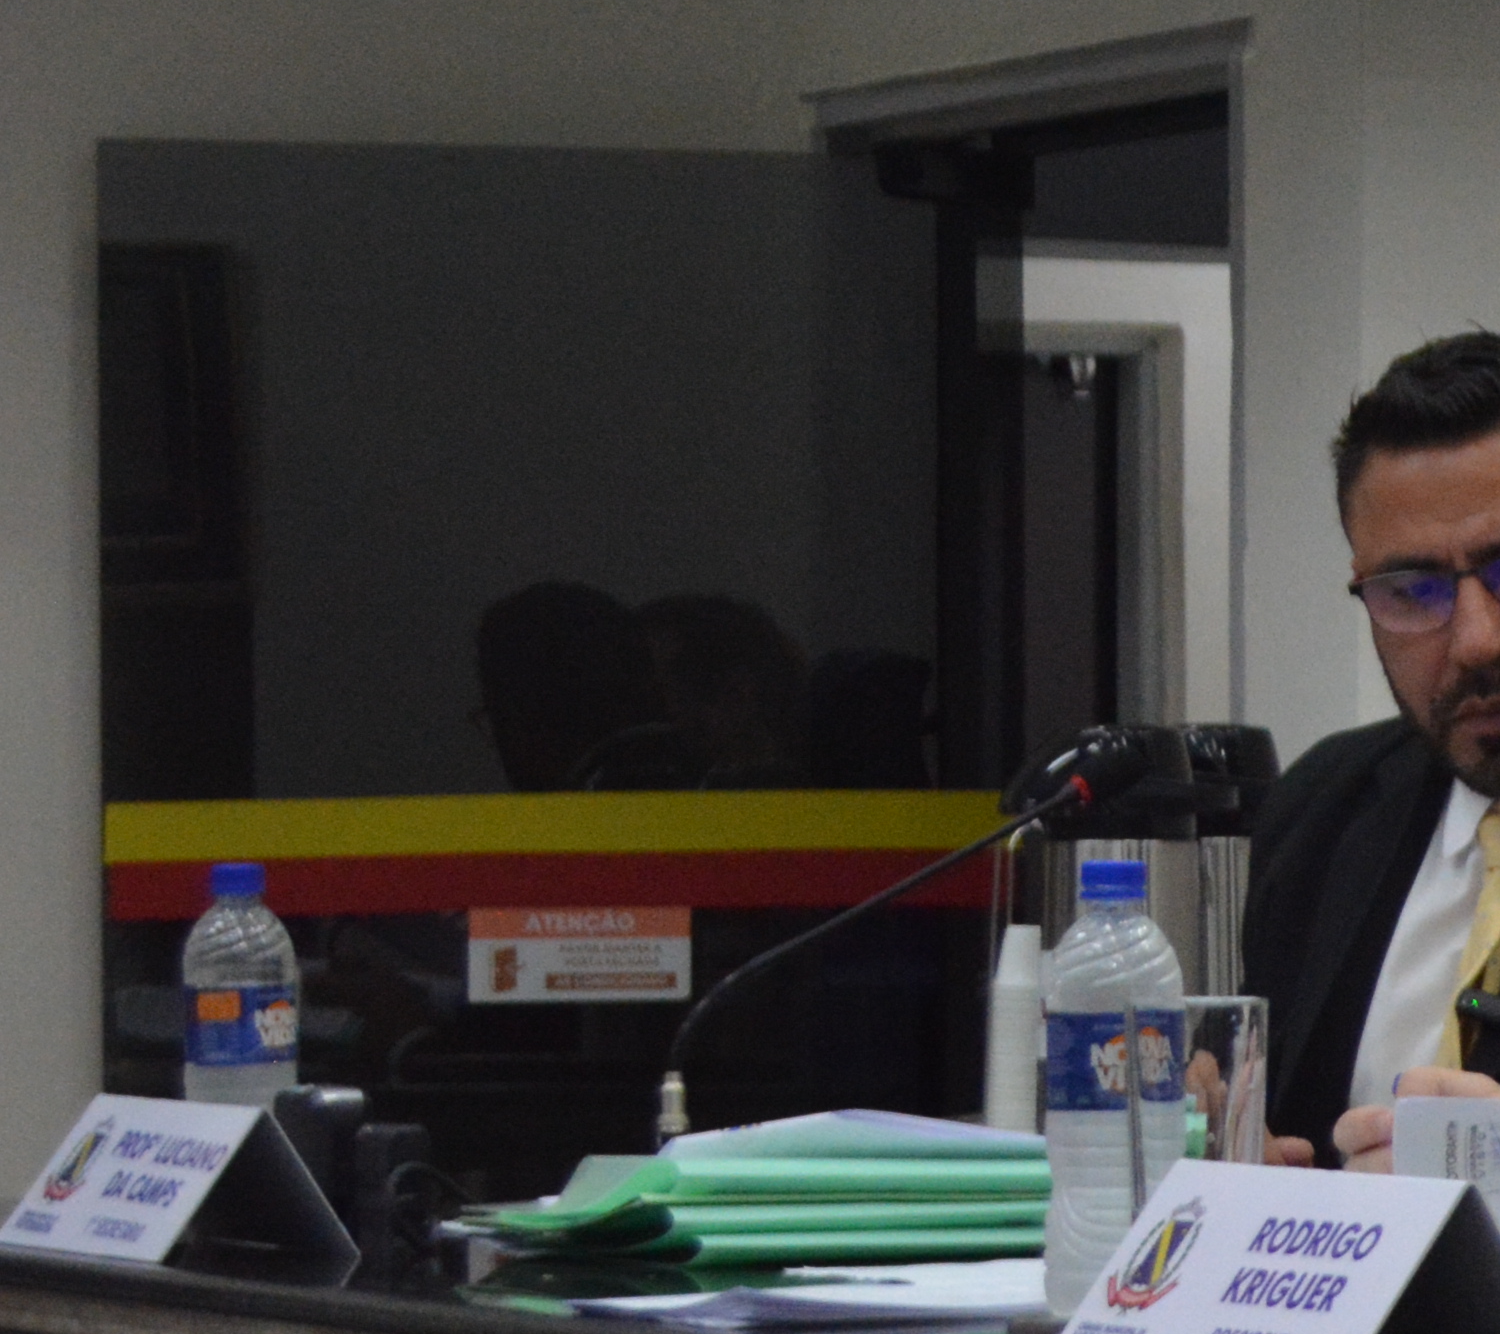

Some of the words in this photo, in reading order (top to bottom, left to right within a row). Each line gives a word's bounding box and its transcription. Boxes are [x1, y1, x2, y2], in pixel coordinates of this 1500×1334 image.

[523, 909, 636, 934] ATENÇÃO
[1247, 1216, 1384, 1261] RODRIGO
[1221, 1266, 1349, 1313] KRIGUER
